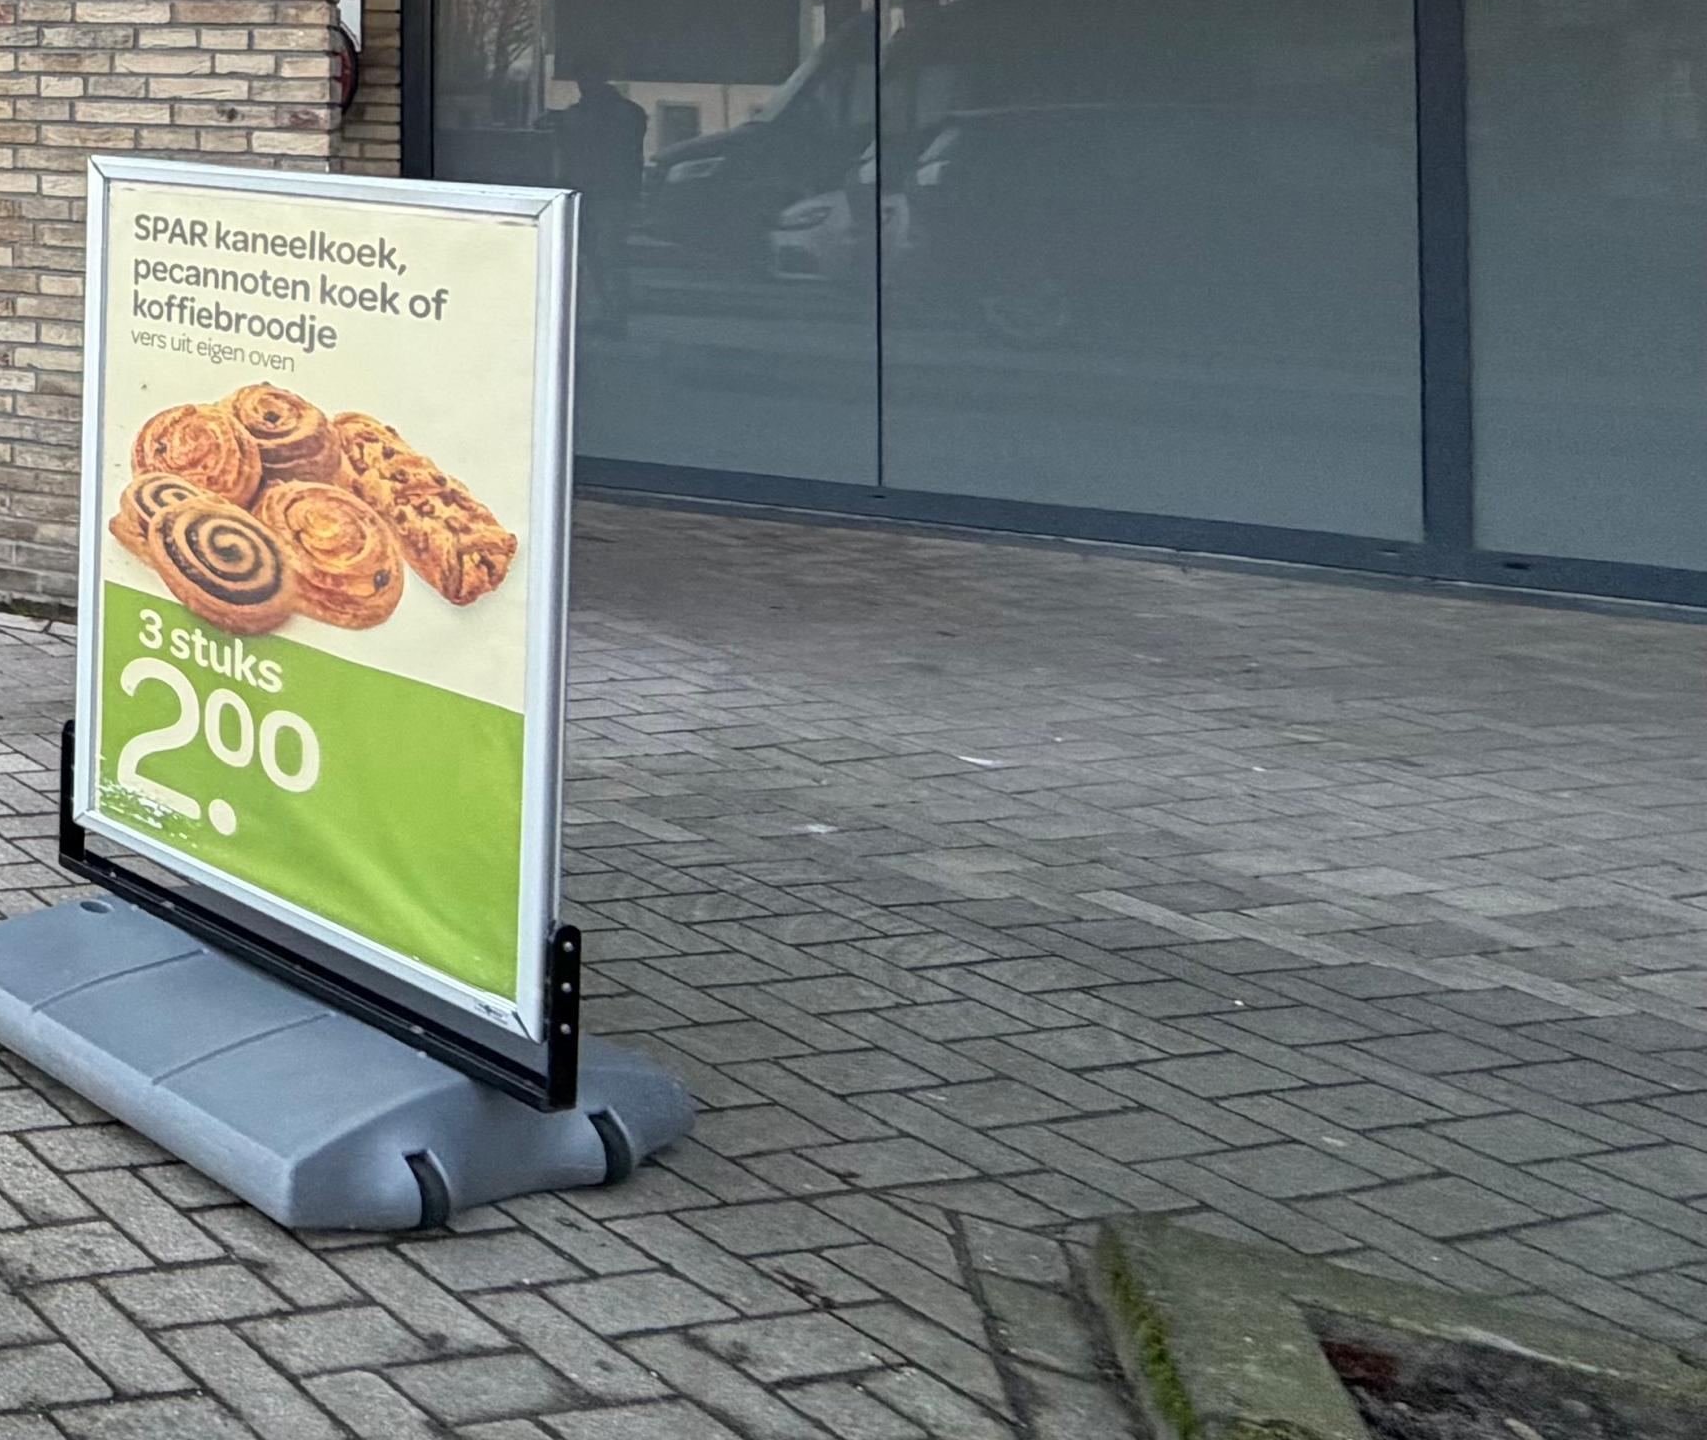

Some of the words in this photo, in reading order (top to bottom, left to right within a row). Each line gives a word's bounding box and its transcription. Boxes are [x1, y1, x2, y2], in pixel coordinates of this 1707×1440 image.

[133, 213, 208, 247] SPAR
[215, 220, 407, 276] kaneelkoek,
[133, 257, 310, 302] pecannoten
[319, 273, 400, 315] koek
[408, 288, 449, 321] of
[130, 327, 167, 350] vers
[171, 331, 192, 354] uit
[196, 337, 245, 364] eigen
[248, 347, 295, 372] oven
[132, 289, 338, 354] koffiebroodje
[138, 607, 164, 649] 3
[170, 627, 284, 694] stuks
